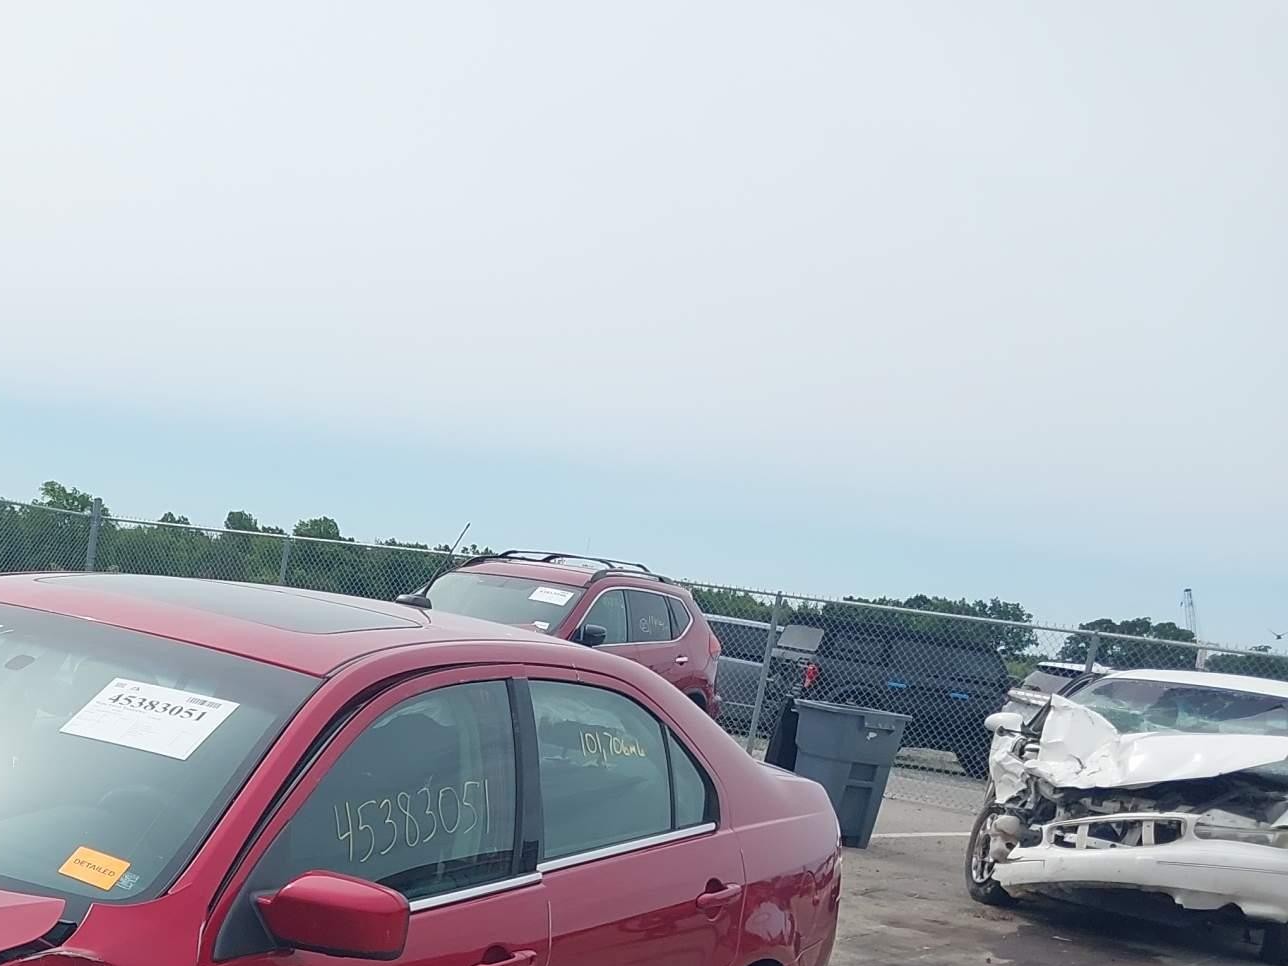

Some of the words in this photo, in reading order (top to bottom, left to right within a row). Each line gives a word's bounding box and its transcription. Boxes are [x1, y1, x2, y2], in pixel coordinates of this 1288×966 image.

[108, 693, 207, 721] 45383051
[334, 779, 490, 862] 45383051
[73, 858, 116, 877] DETAILED
